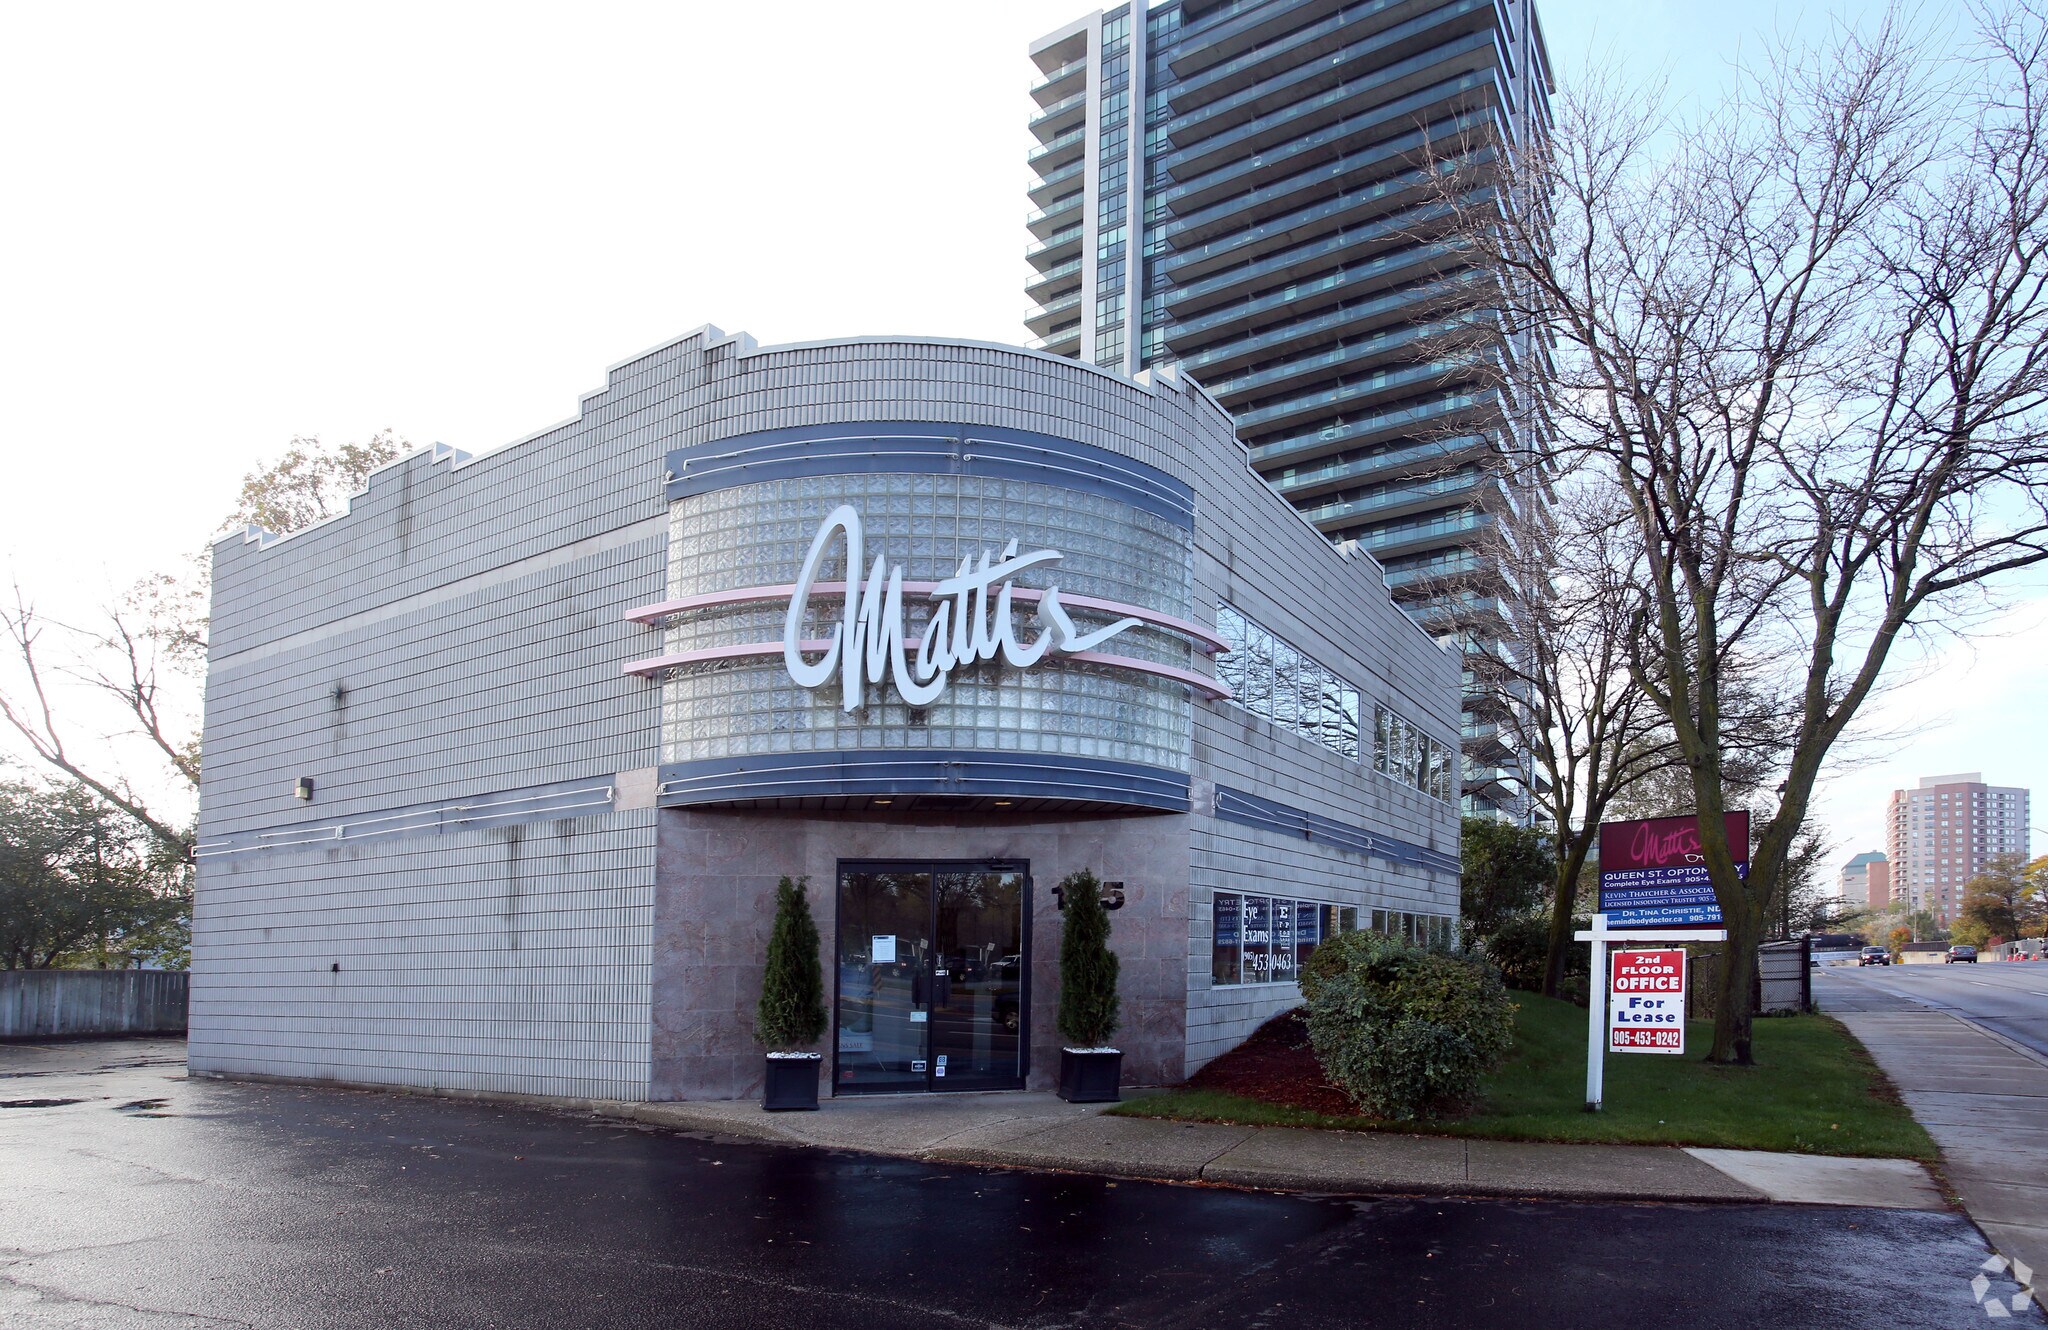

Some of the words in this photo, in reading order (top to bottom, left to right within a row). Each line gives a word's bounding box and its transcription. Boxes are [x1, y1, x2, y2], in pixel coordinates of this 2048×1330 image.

[1604, 872, 1645, 880] QUEEN
[1604, 880, 1639, 888] Complete
[1629, 890, 1669, 898] THATCHER
[1243, 901, 1258, 925] Eye
[1279, 907, 1288, 918] E
[1661, 907, 1704, 915] CHRISTIE,
[1243, 925, 1269, 943] Exams
[1635, 955, 1660, 964] 2nd
[1621, 966, 1674, 974] FLOOR
[1616, 976, 1679, 990] OFFICE
[1629, 997, 1665, 1008] For
[1618, 1011, 1675, 1022] Lease
[1613, 1030, 1679, 1046] 905-453-0242
